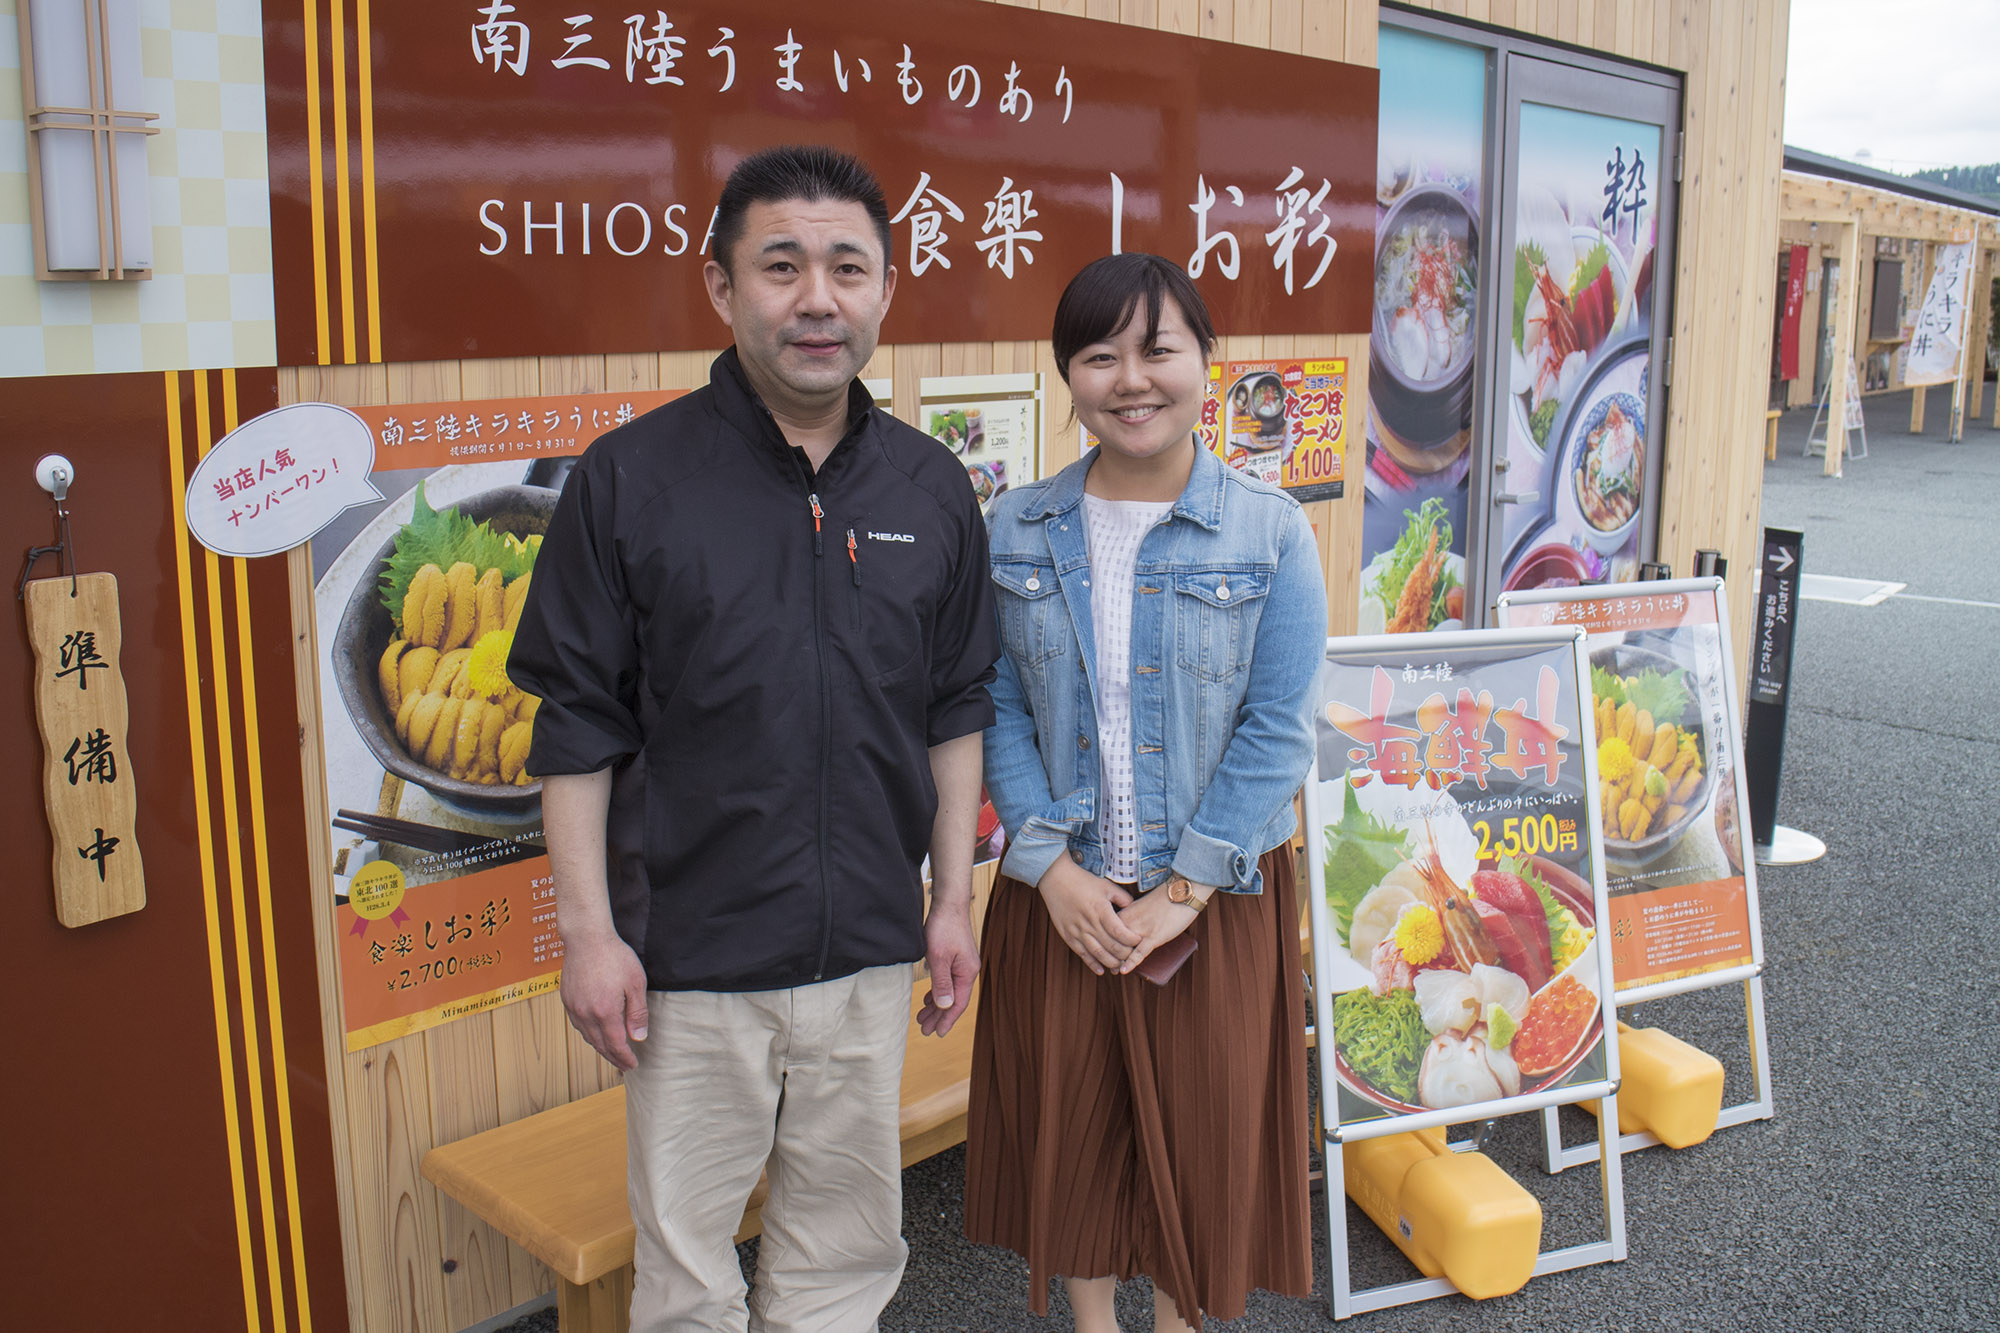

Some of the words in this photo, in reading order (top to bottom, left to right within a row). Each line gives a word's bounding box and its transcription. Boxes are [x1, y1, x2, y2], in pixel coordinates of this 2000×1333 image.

[471, 0, 1073, 125] 南三陸うまいものあり
[1602, 145, 1648, 246] 粋
[1937, 249, 1965, 335] キラキラ
[1912, 284, 1937, 357] うに丼
[1304, 375, 1344, 390] ご当地ラーメン
[1311, 362, 1336, 372] ランチのみ
[380, 402, 637, 447] 南三陸キラキラうに丼
[1284, 390, 1344, 420] たこつぼ
[1290, 417, 1343, 446] ラーメン
[213, 448, 296, 502] 当店人気
[1286, 446, 1341, 484] 1,100円
[867, 531, 916, 544] HEAD
[1542, 592, 1686, 624] 南三陸キラキラうに丼
[1776, 579, 1790, 625] こちらへ
[1760, 594, 1777, 674] お進みください
[1402, 661, 1454, 684] 南三陸
[1759, 686, 1778, 696] please
[1325, 664, 1570, 791] 海鮮丼
[55, 630, 121, 883] 準備中
[1472, 813, 1578, 863] 2,500円
[367, 897, 511, 966] 食楽しお彩
[441, 983, 524, 1019] Minamisanriku
